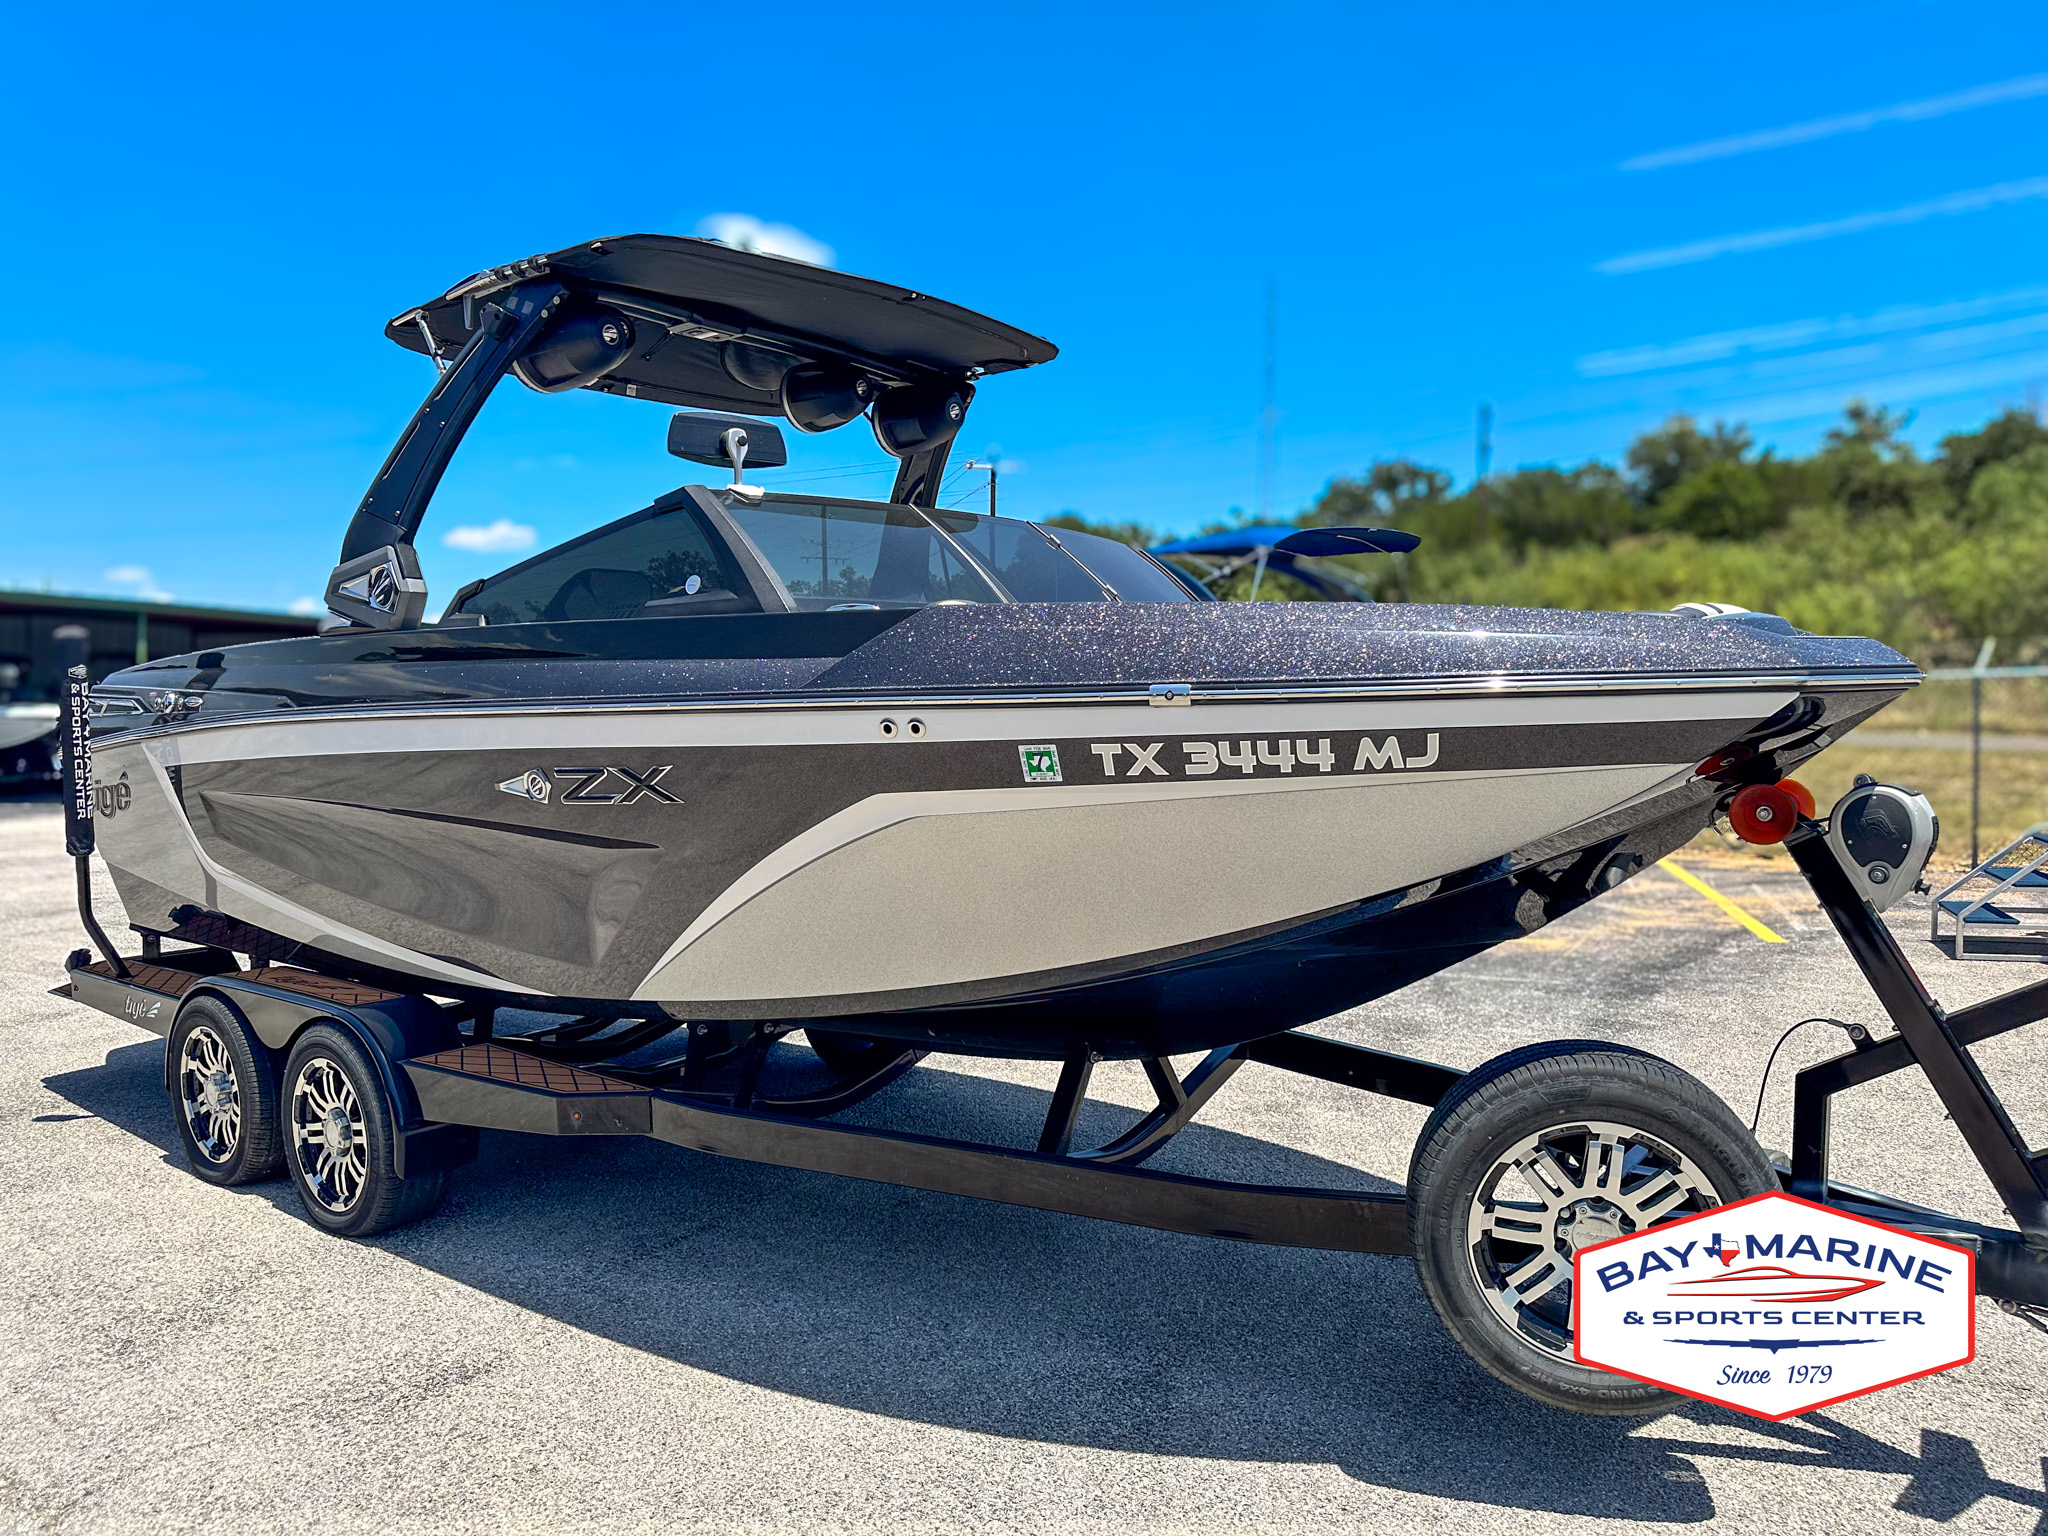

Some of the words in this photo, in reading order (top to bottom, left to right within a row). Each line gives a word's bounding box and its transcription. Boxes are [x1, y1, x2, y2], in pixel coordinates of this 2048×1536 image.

[70, 683, 80, 694] &
[71, 696, 83, 757] SPORTS
[1090, 742, 1170, 776] TX
[1182, 738, 1336, 775] 3444
[1353, 732, 1440, 771] MJ
[74, 759, 87, 820] CENTER
[554, 764, 685, 805] ZX
[1598, 1385, 1660, 1400] SWIND
